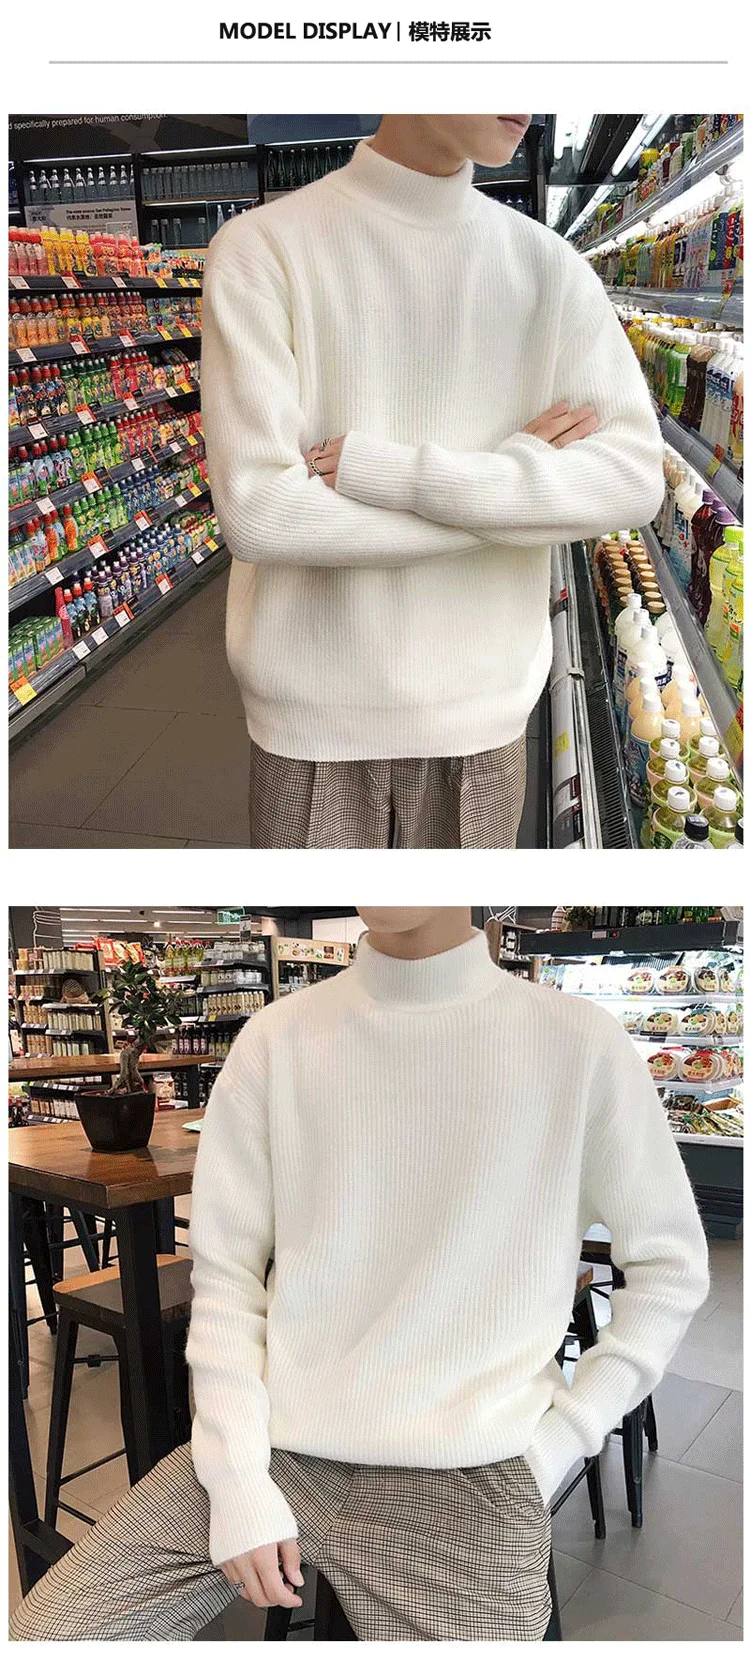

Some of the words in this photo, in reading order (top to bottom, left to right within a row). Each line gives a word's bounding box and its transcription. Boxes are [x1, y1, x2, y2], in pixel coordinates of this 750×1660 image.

[13, 120, 51, 131] specifically
[51, 117, 83, 128] prepared
[83, 116, 94, 125] for
[94, 115, 120, 123] human
